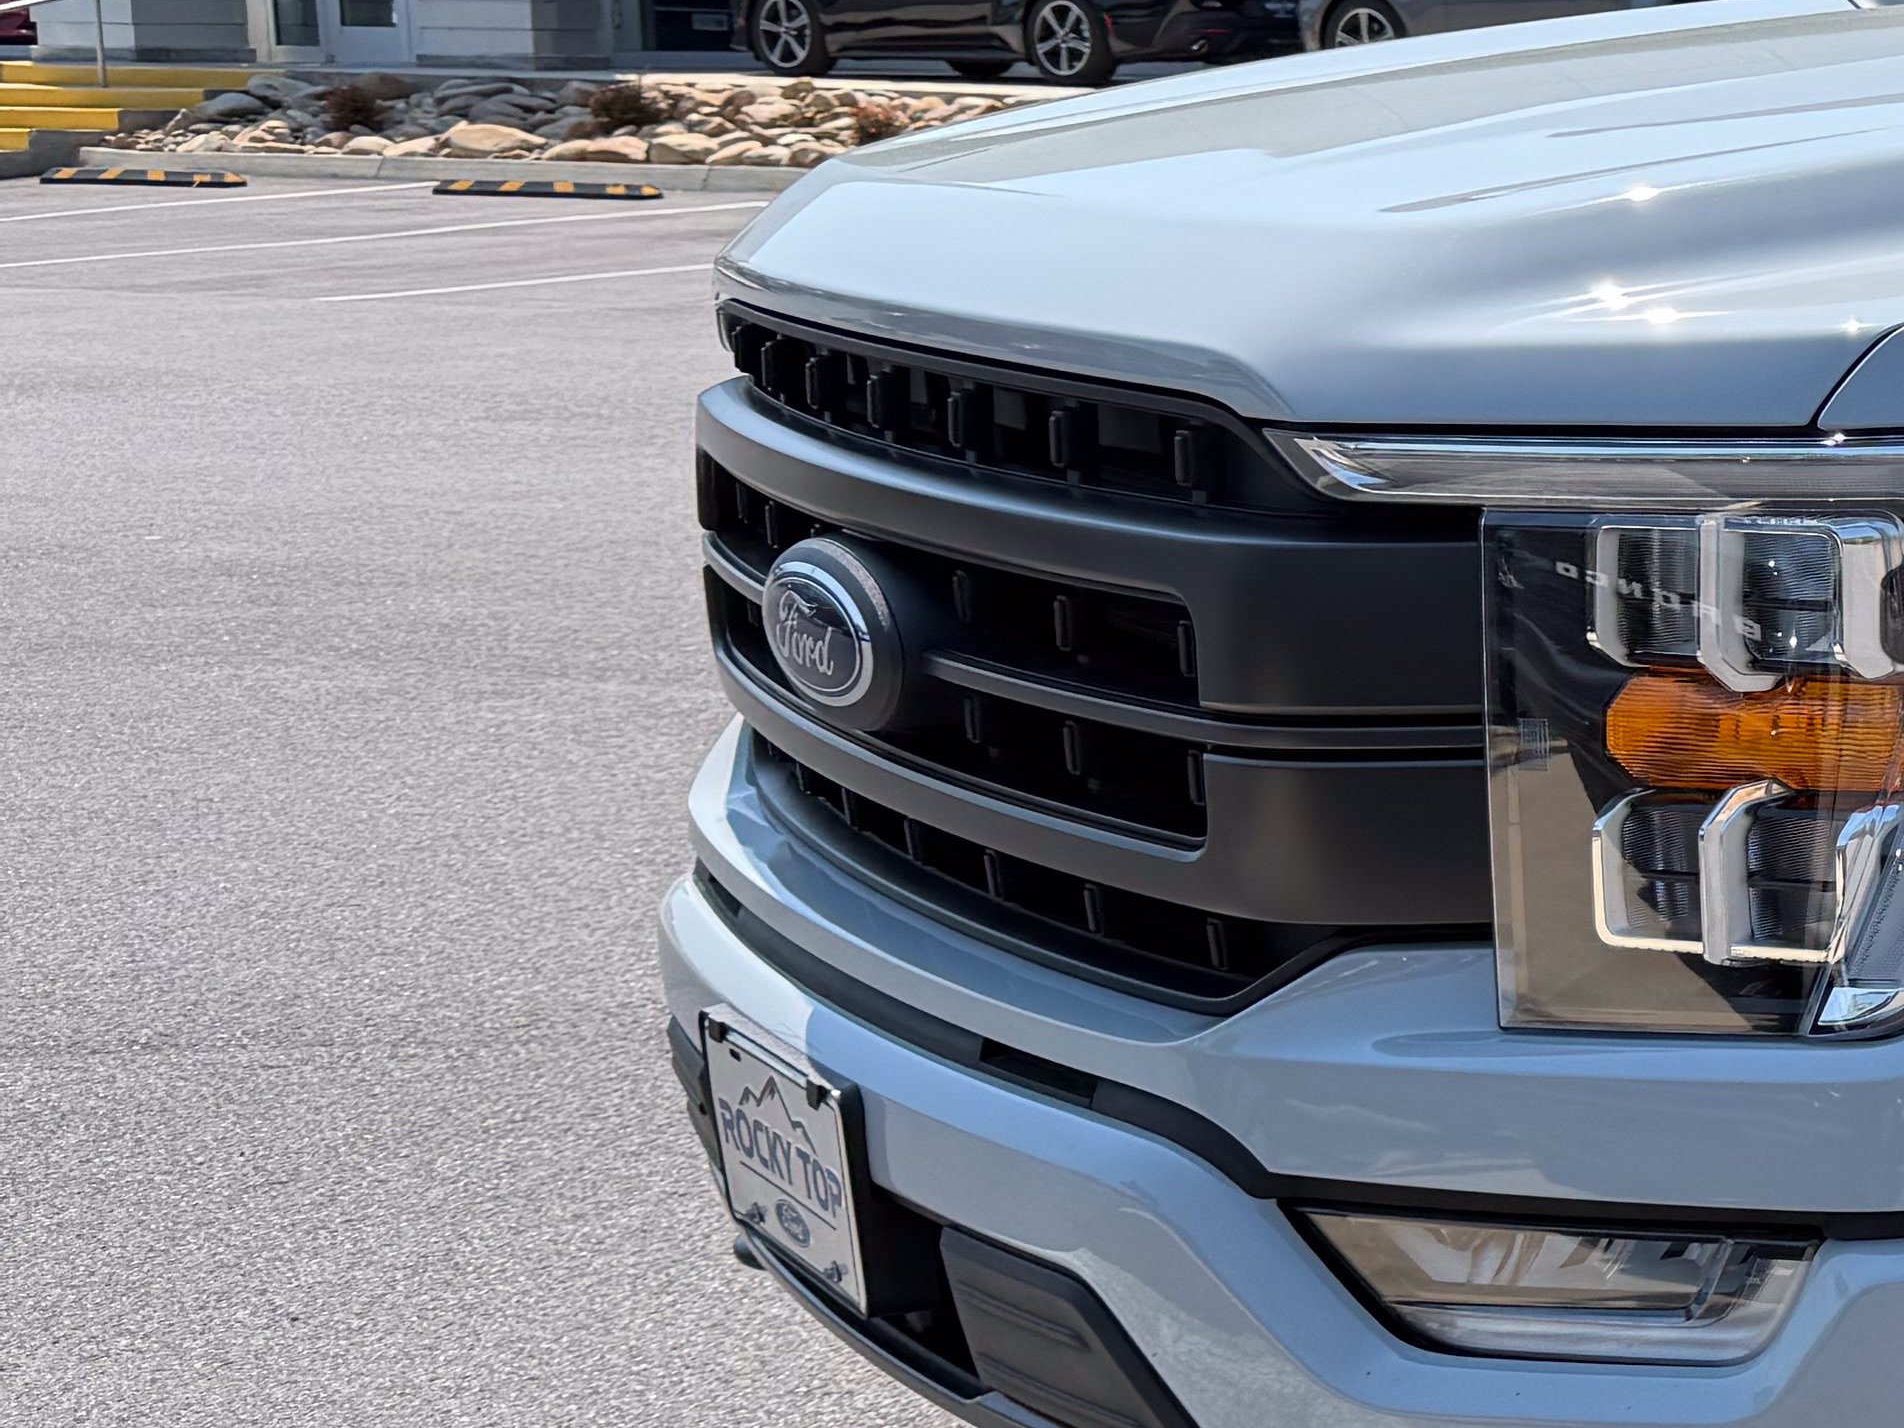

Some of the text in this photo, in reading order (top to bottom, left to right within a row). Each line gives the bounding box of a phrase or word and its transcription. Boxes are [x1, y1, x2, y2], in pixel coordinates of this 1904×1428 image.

[776, 590, 834, 677] Ford
[718, 1097, 842, 1219] ROCKY TOP
